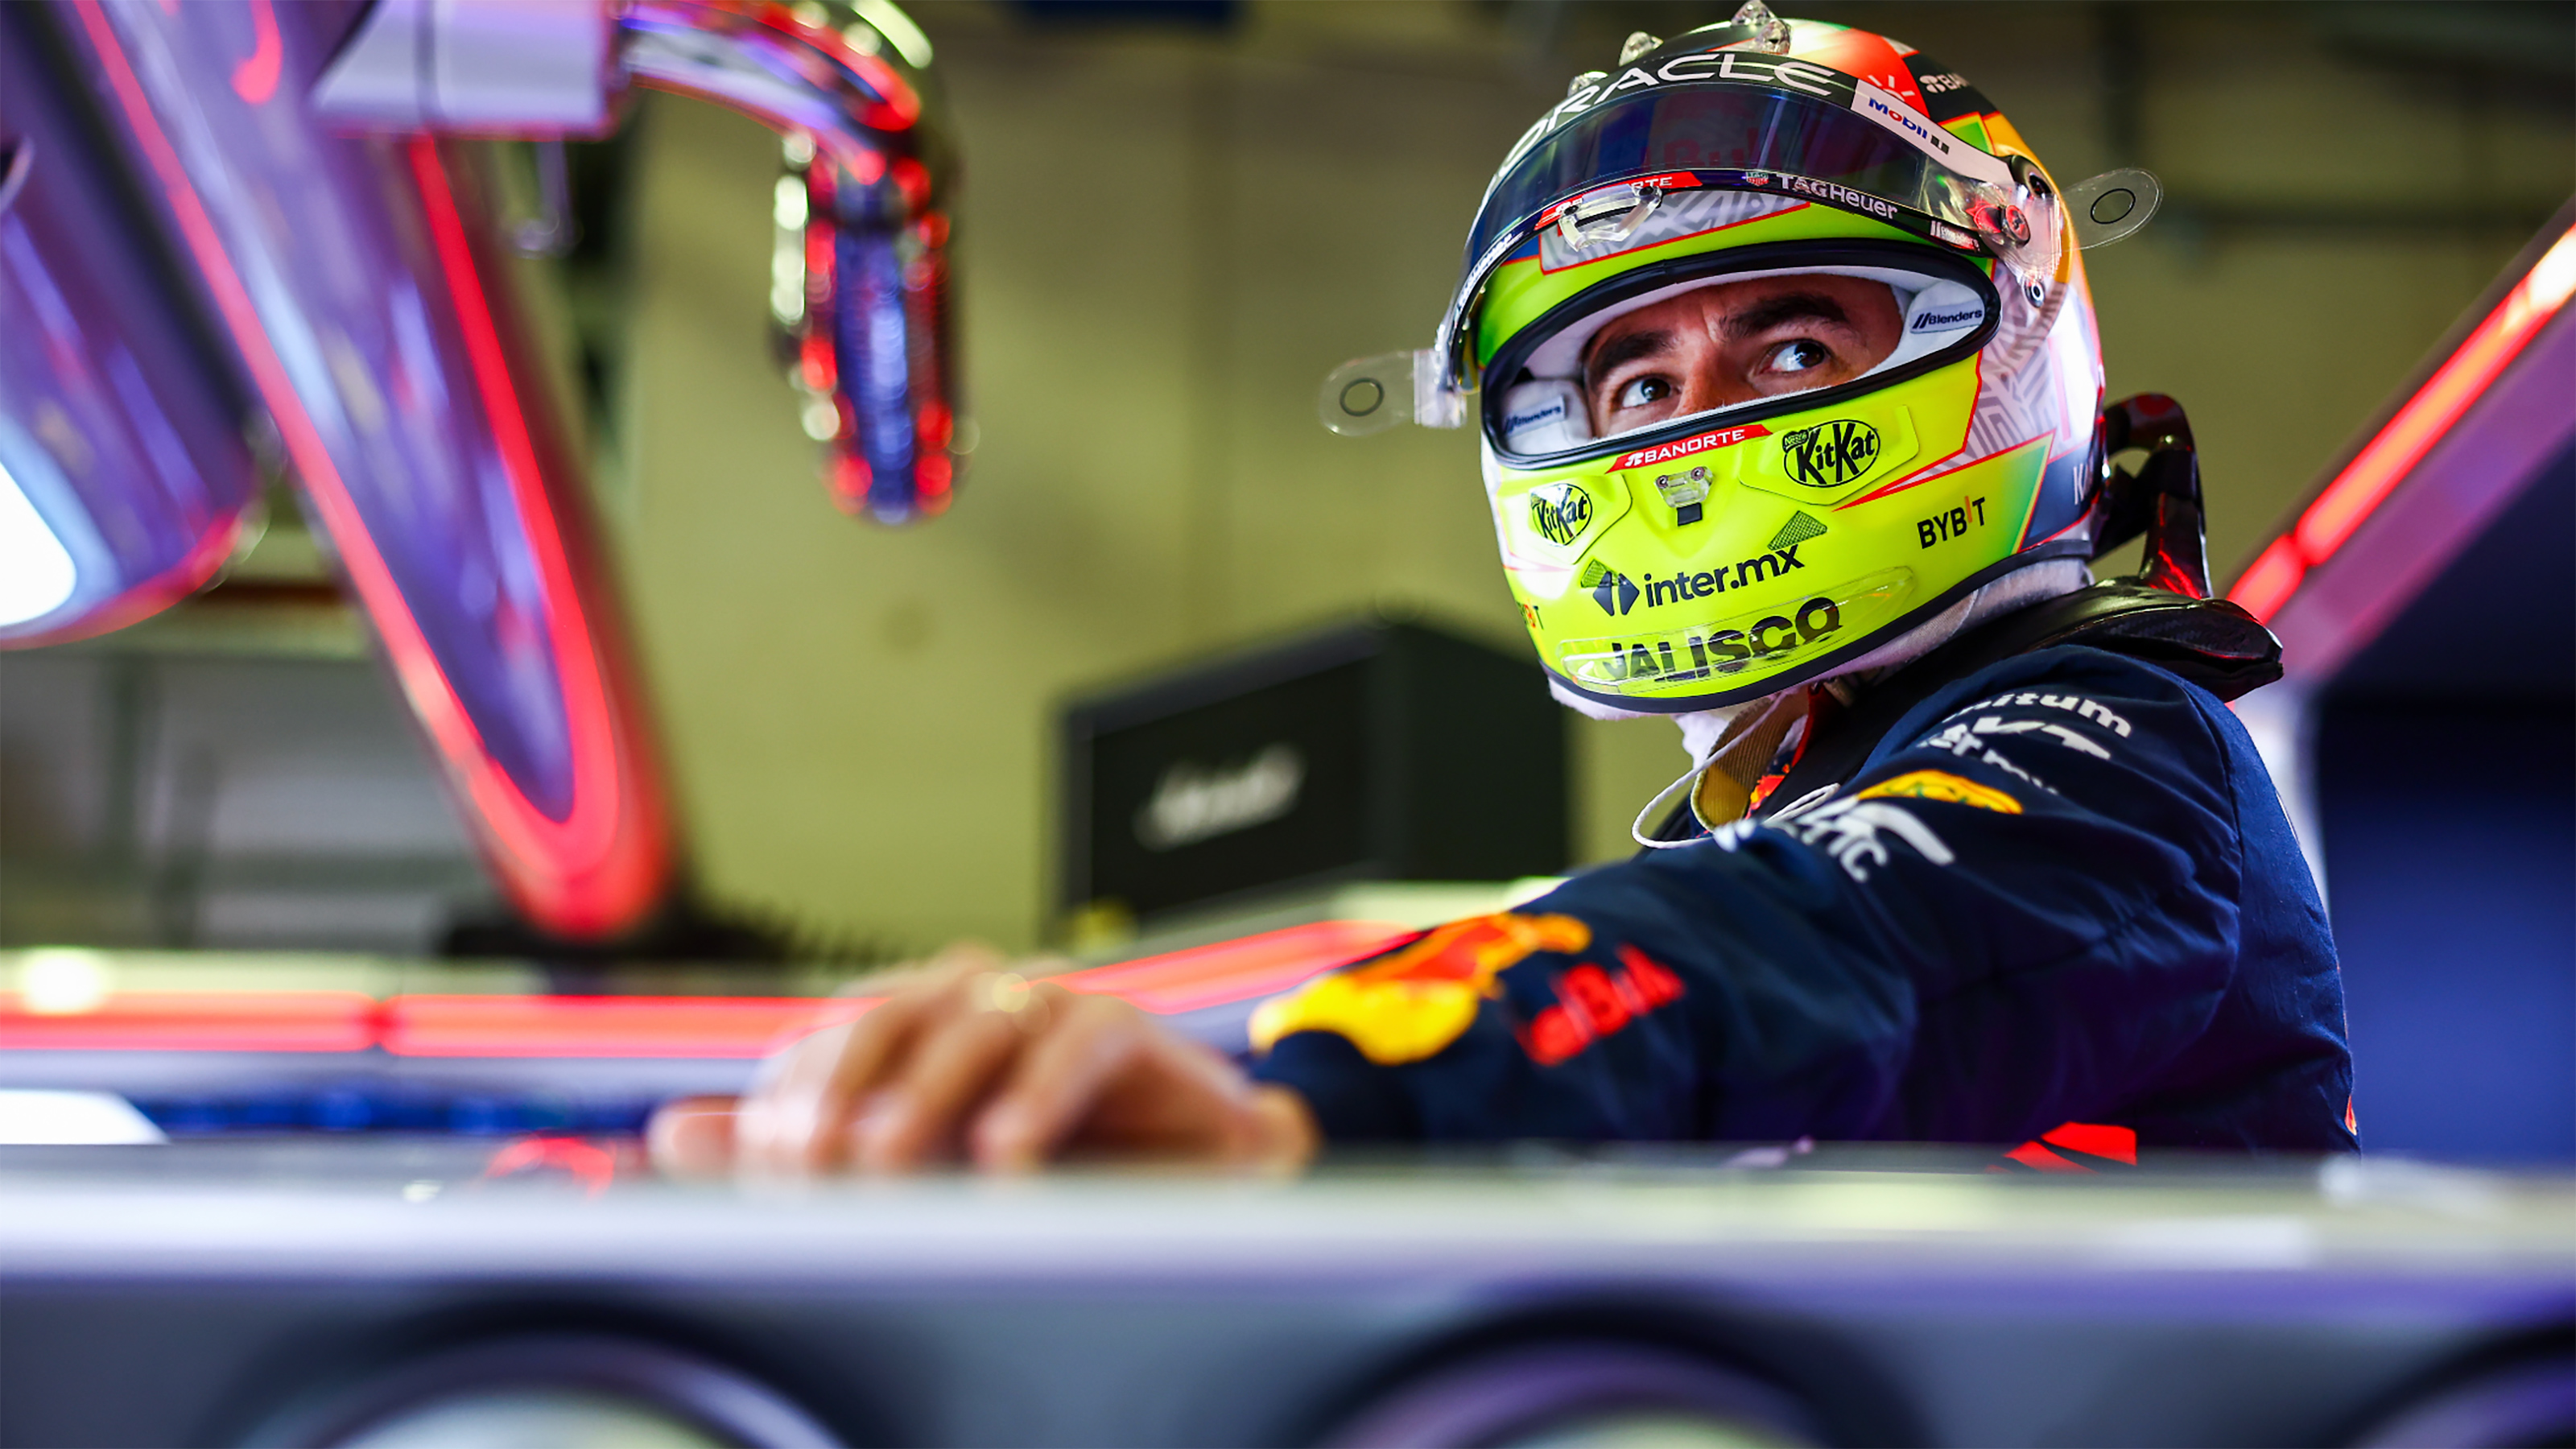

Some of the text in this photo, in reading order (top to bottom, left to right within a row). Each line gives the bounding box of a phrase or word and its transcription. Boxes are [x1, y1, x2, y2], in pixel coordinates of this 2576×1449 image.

[1497, 52, 1835, 178] ORACLE
[1868, 97, 1927, 139] Mobil
[1929, 310, 1983, 325] Blenders
[1645, 429, 1745, 464] BANORTE
[1795, 422, 1876, 485] KitKat
[1536, 487, 1587, 543] KitKat
[1918, 496, 1987, 549] BYBIT
[1644, 544, 1805, 608] inter.mx
